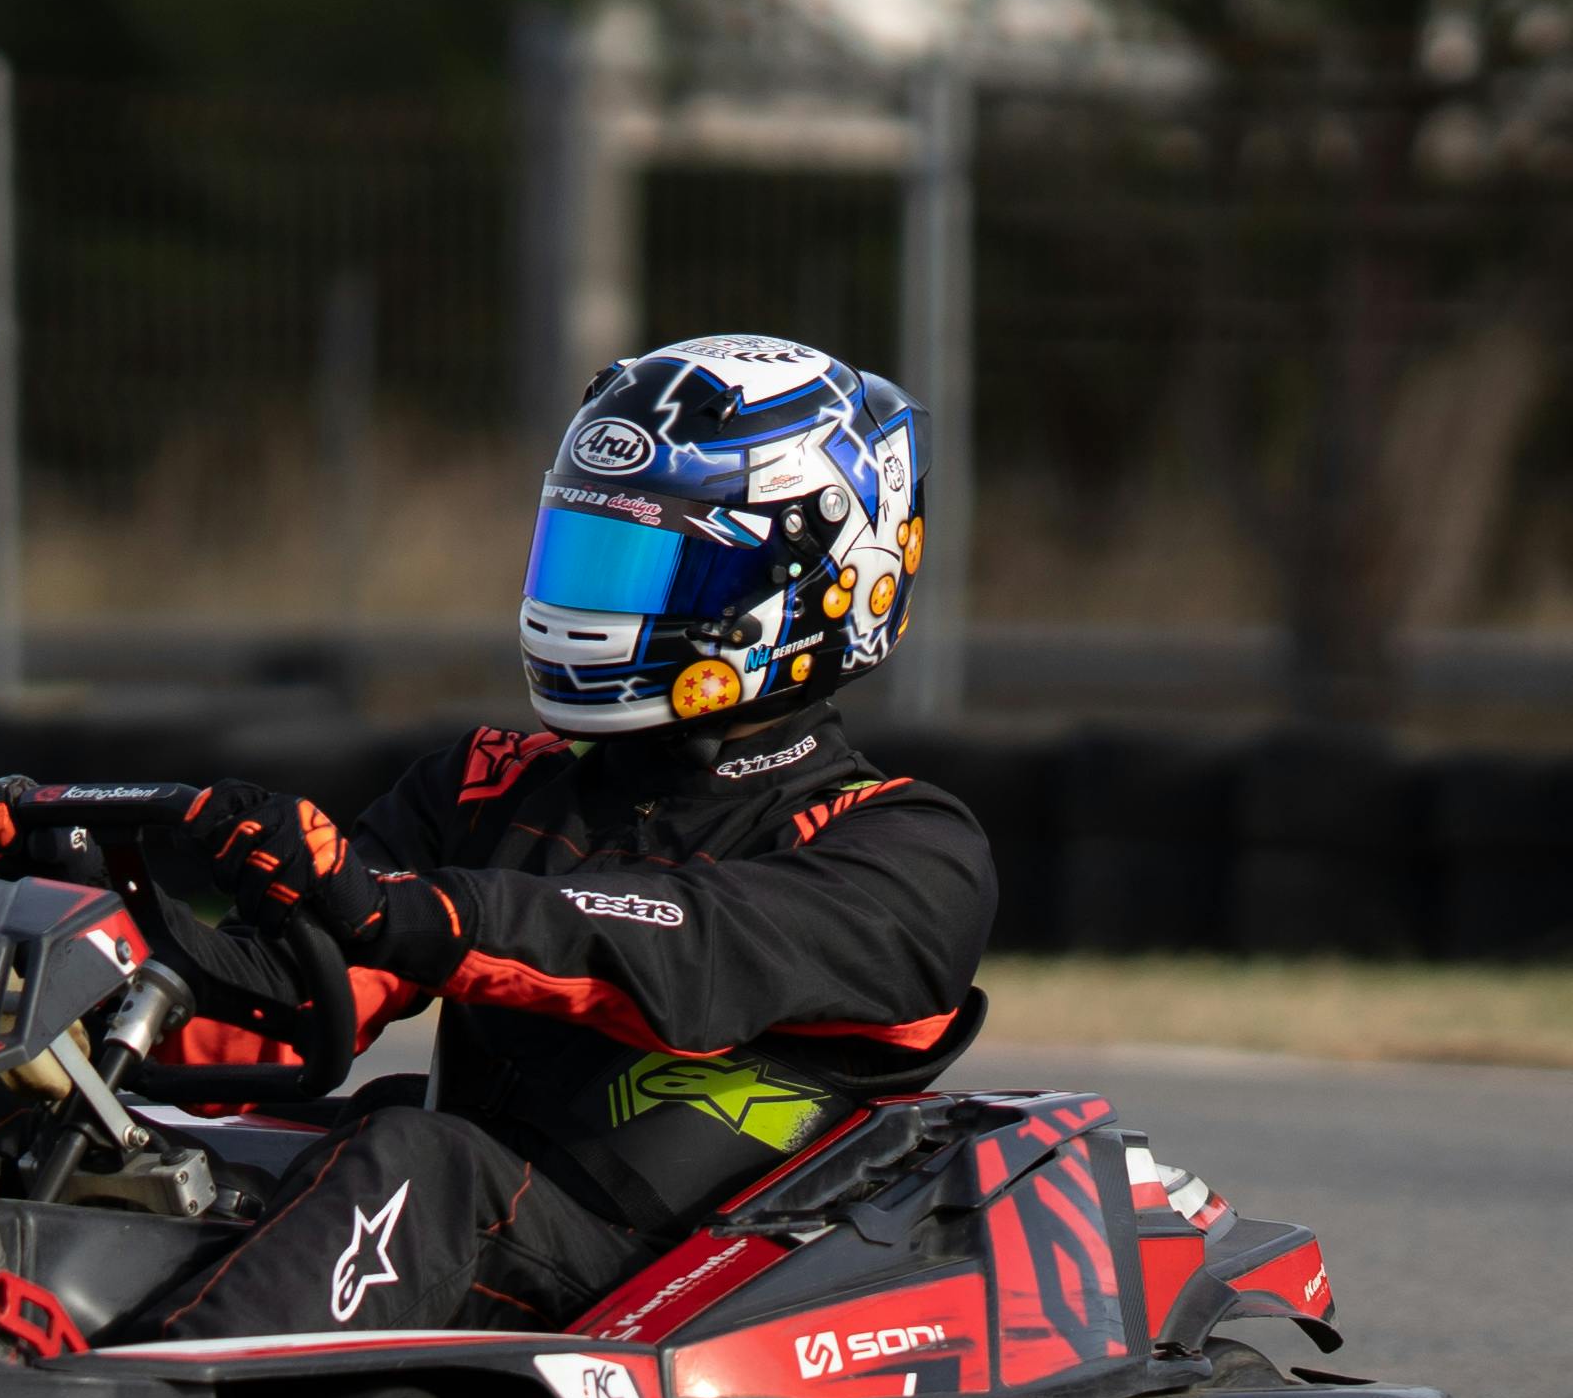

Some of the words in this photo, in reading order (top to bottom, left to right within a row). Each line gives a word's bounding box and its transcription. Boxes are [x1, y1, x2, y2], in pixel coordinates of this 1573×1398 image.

[574, 424, 644, 460] Arai
[745, 644, 773, 673] Nil
[847, 1325, 945, 1361] SODI
